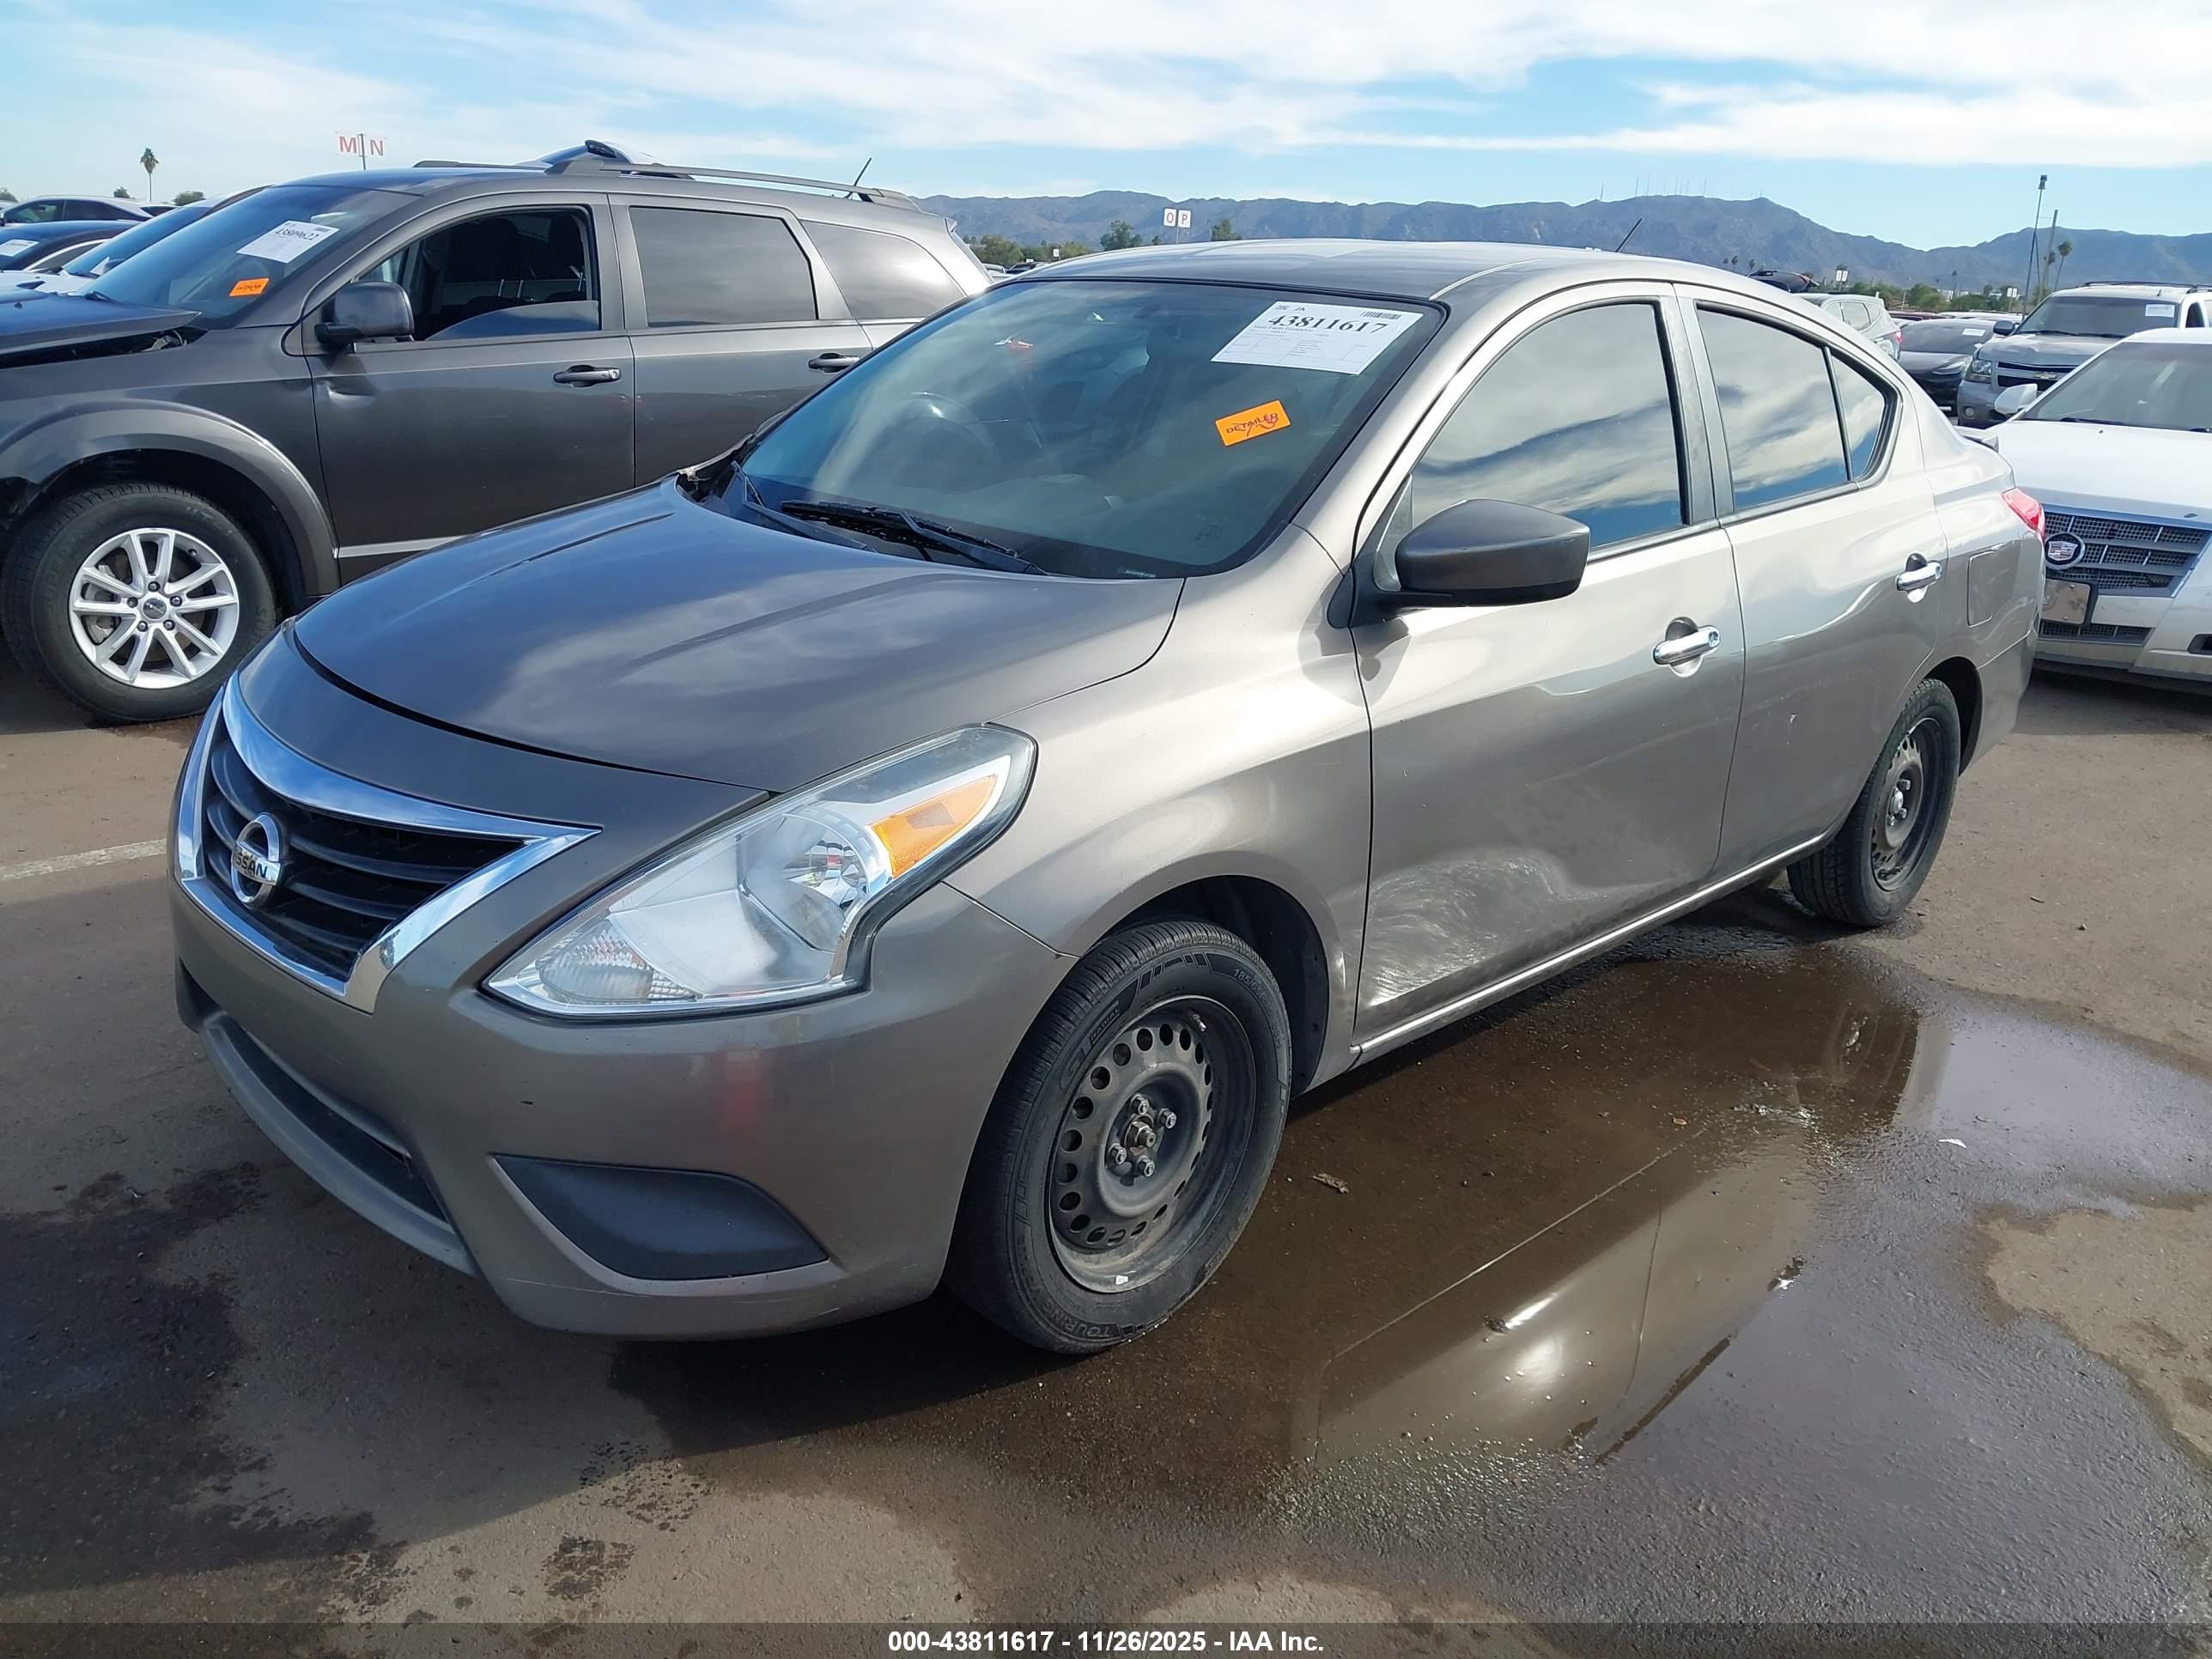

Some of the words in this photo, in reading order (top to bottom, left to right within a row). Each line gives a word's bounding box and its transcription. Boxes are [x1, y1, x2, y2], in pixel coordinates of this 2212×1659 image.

[338, 136, 357, 154] M
[369, 138, 384, 156] N
[1166, 212, 1175, 223] O
[1181, 213, 1188, 225] P
[1267, 313, 1389, 334] 43811617
[235, 851, 269, 879] SSAN
[1043, 1297, 1111, 1338] TOURING
